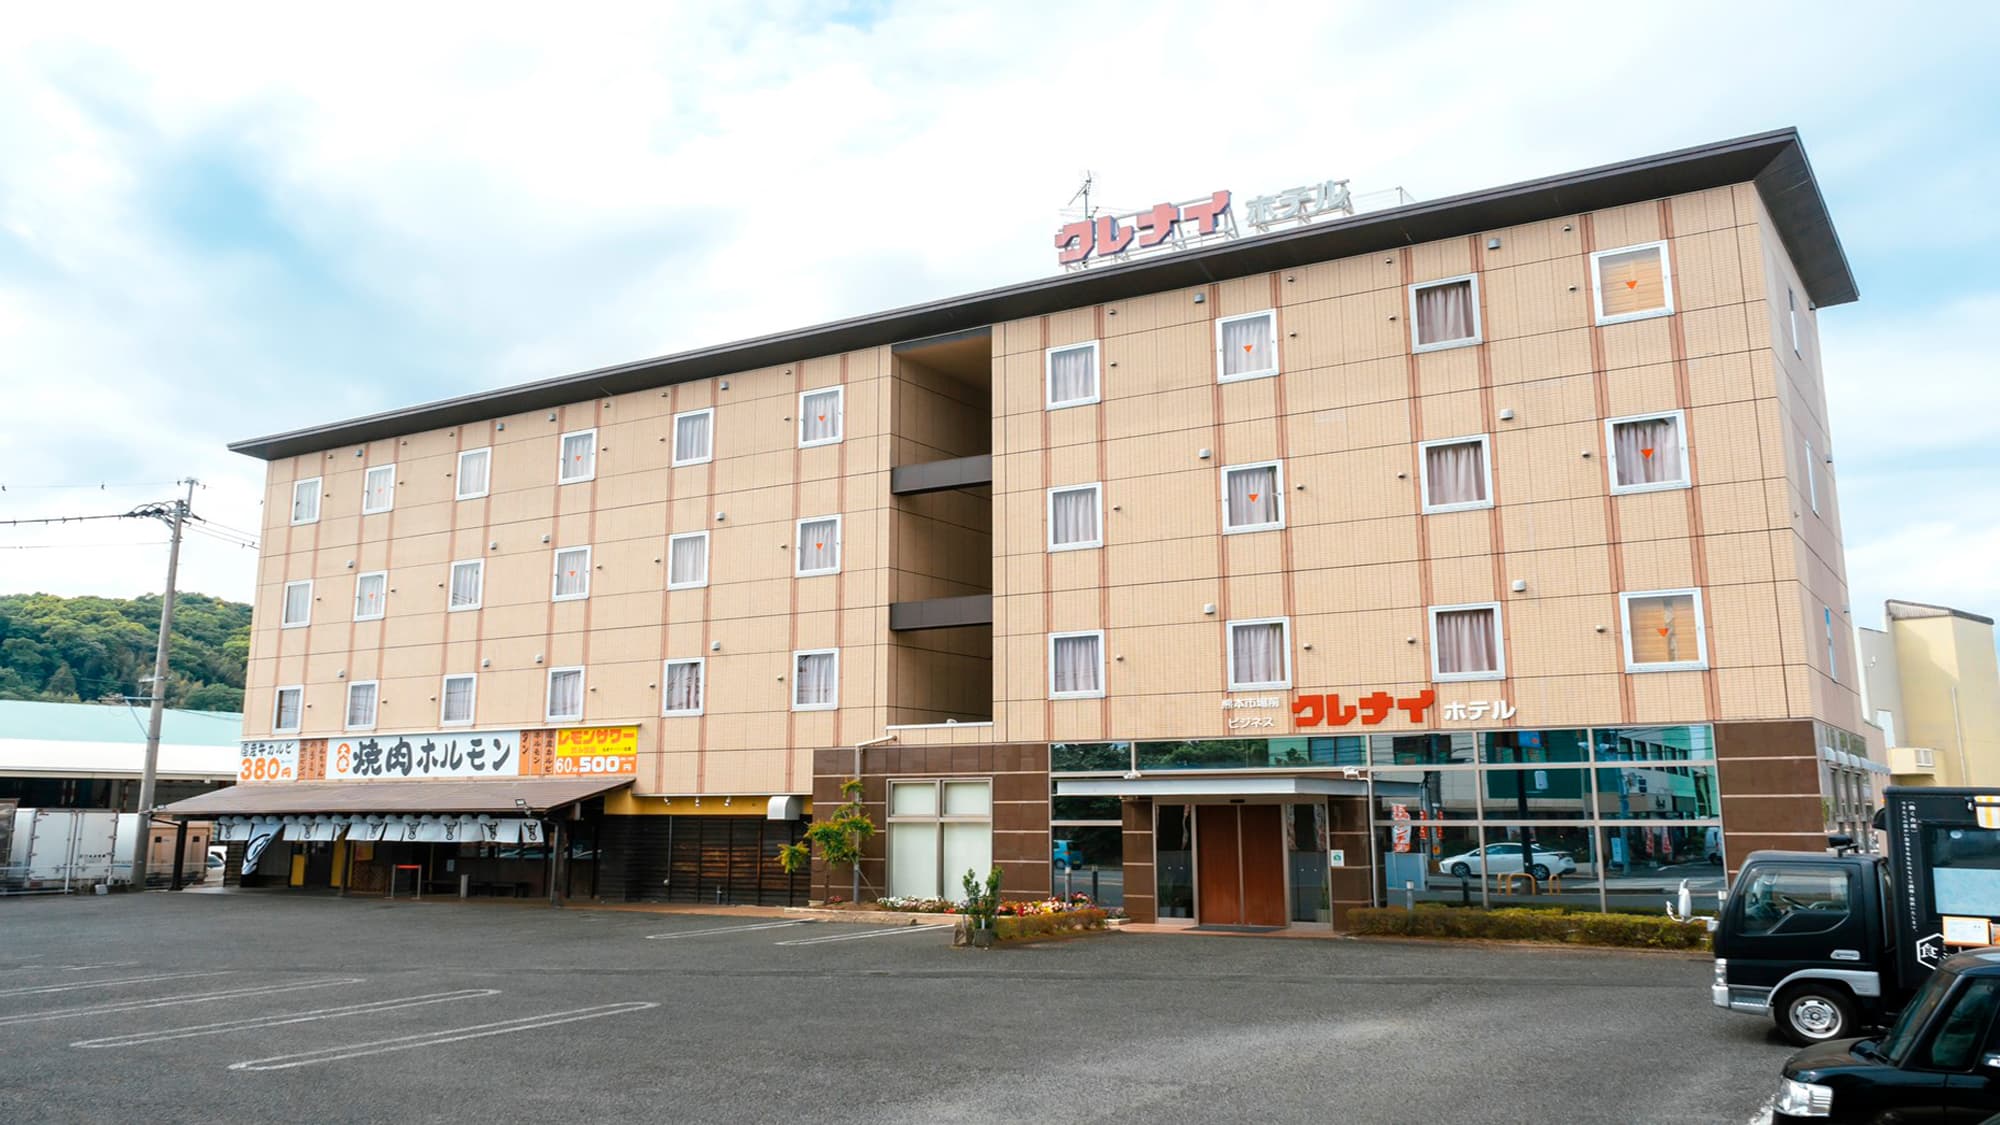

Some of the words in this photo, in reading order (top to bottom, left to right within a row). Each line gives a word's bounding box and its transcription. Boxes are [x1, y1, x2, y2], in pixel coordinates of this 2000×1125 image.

[1054, 189, 1232, 265] クレナイ
[1246, 179, 1350, 224] ホテル
[1228, 716, 1274, 729] ビジネス
[1292, 690, 1435, 727] クレナイ
[1443, 700, 1517, 721] ホテル
[558, 728, 635, 745] レモンサワー
[240, 757, 292, 780] 380円
[352, 737, 511, 776] 焼肉ホルモン
